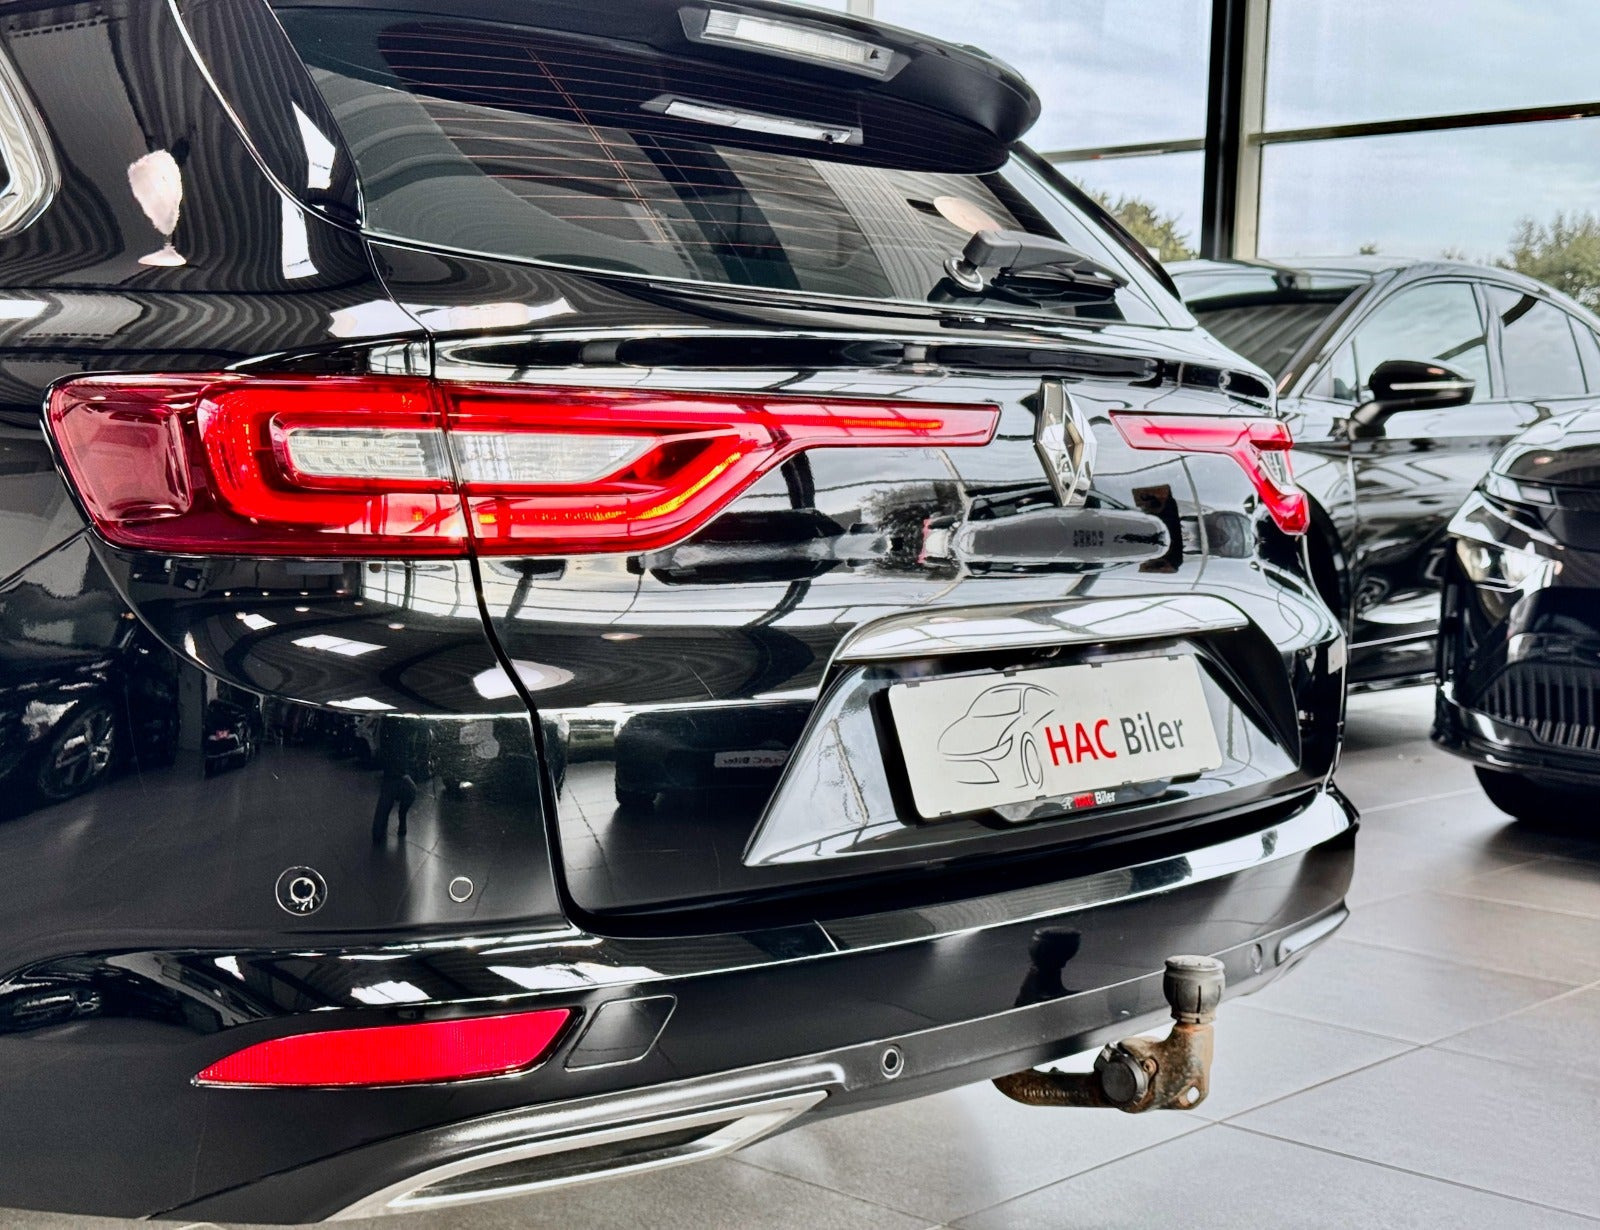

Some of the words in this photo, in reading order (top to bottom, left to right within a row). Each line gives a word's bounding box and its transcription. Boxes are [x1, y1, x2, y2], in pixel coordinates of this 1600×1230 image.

[1044, 719, 1117, 766] HAC
[1120, 711, 1184, 755] Biler
[1094, 790, 1116, 805] Biler
